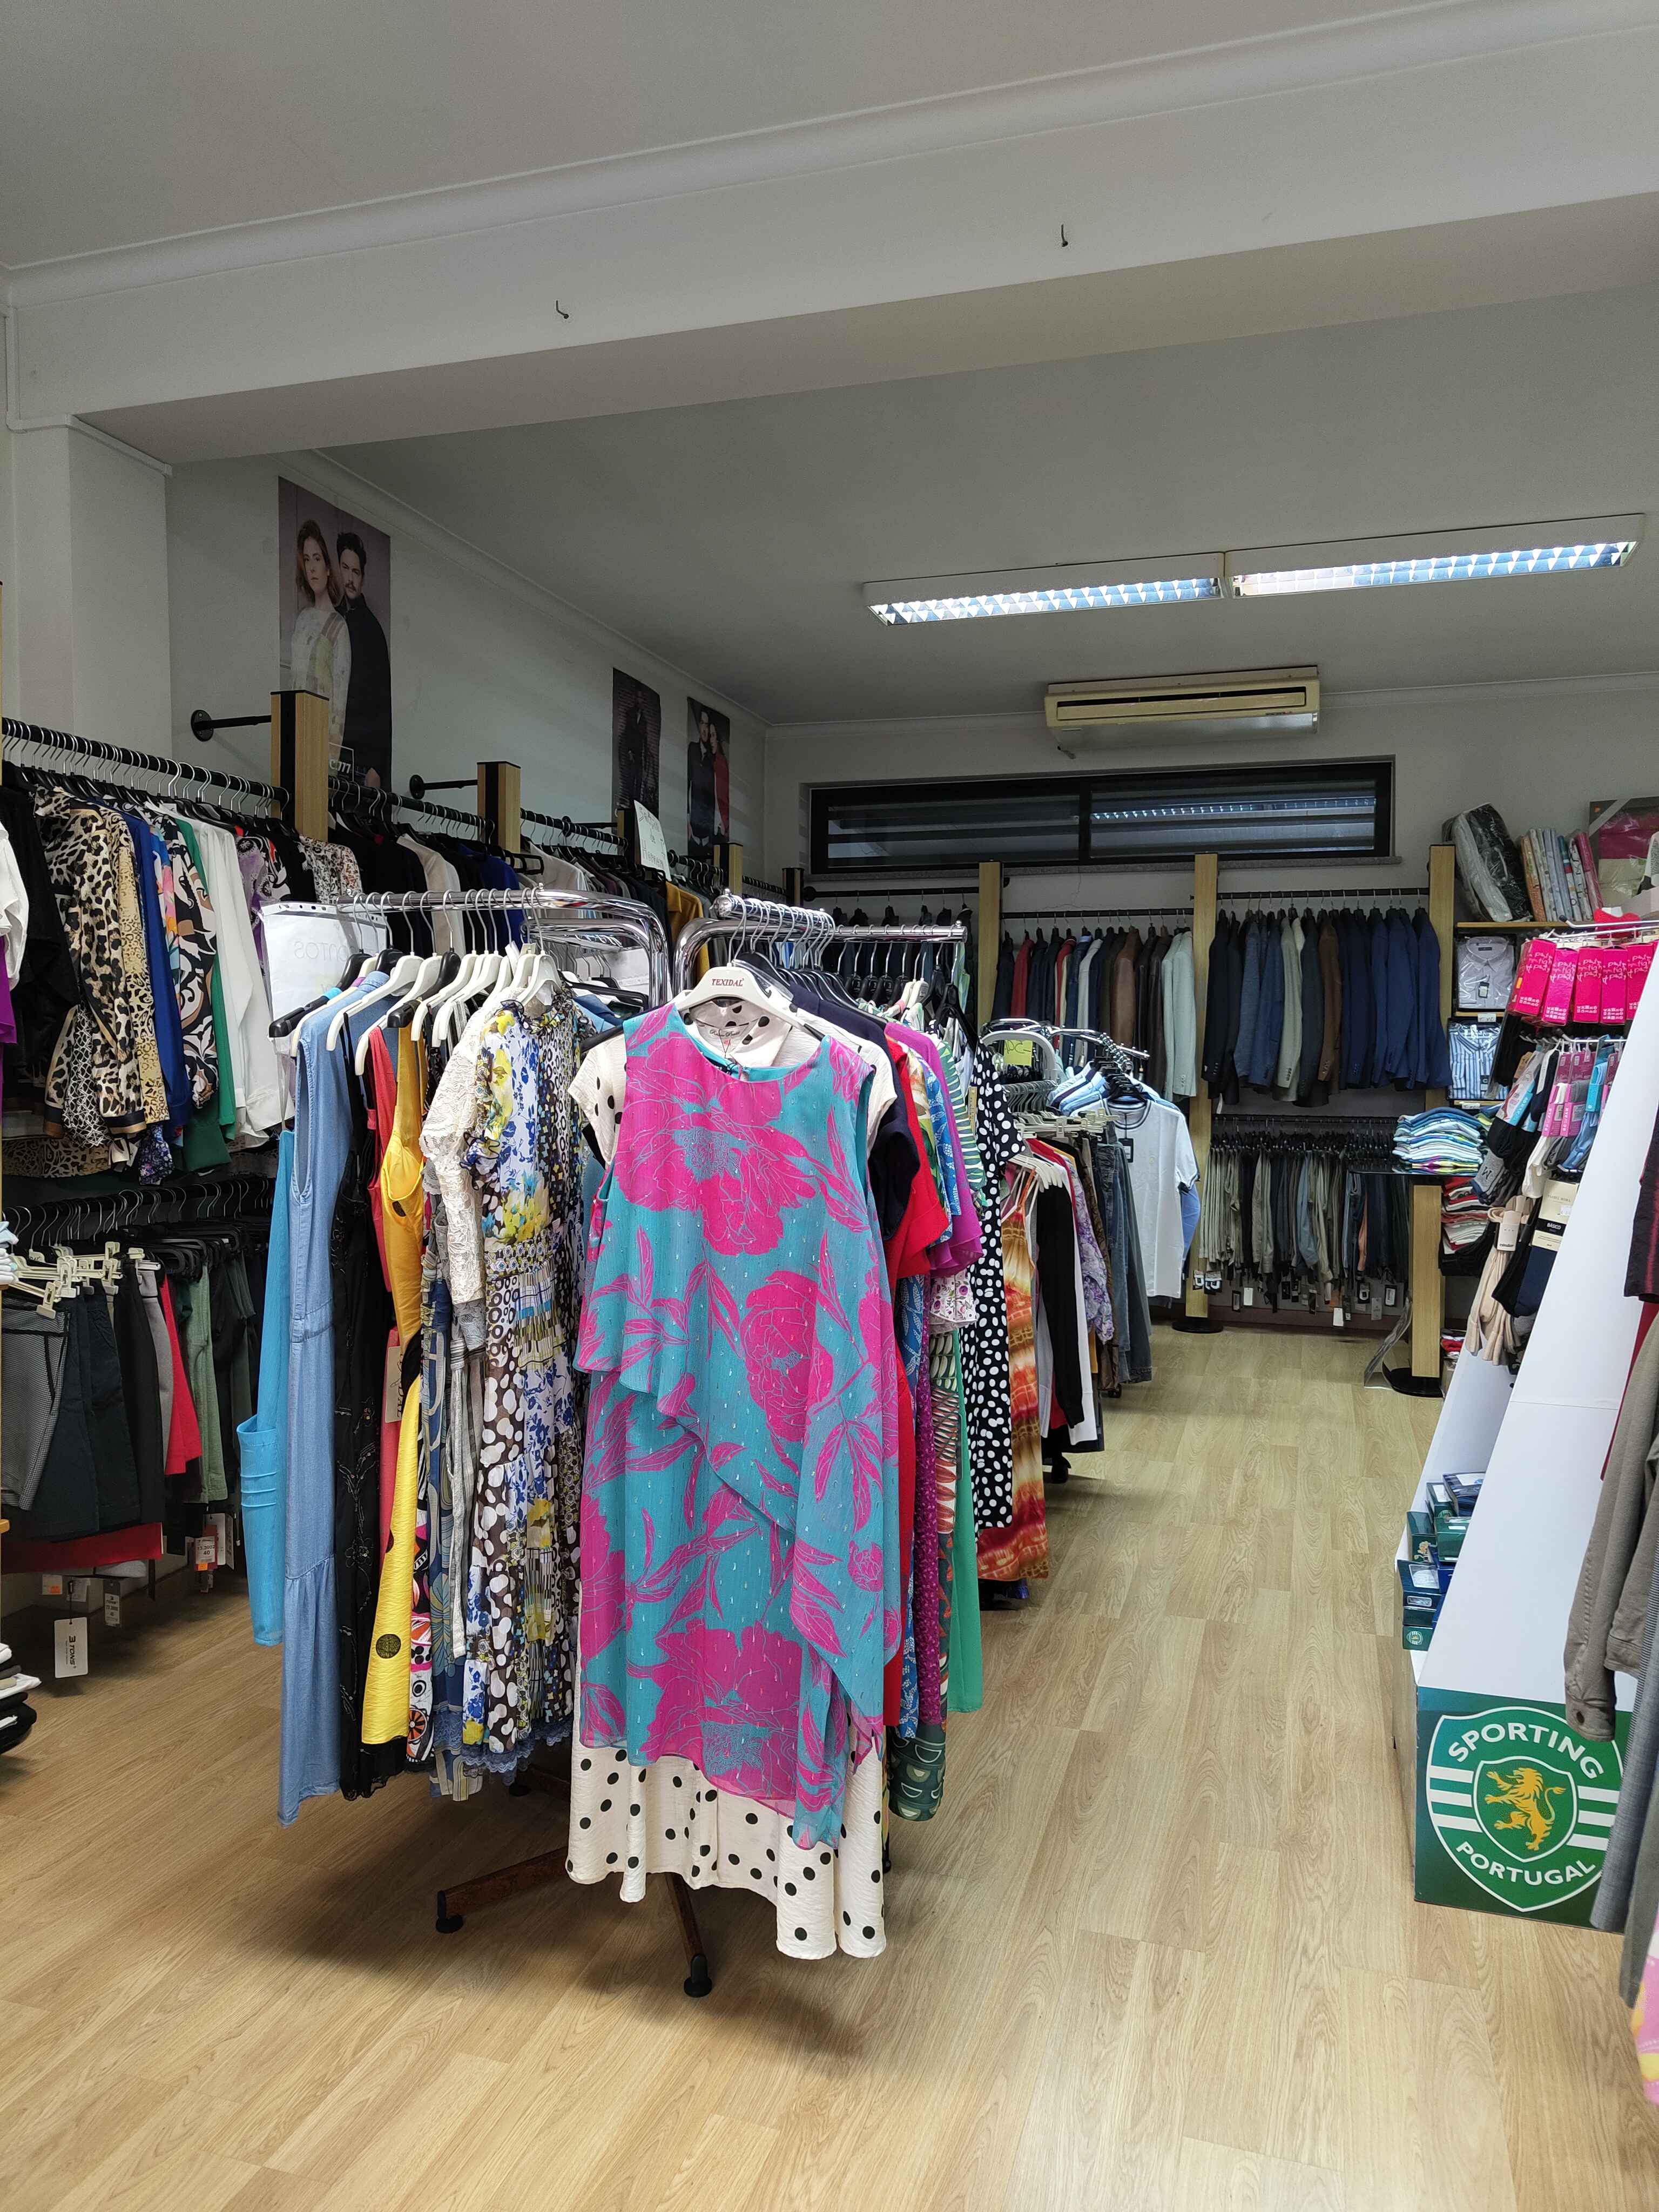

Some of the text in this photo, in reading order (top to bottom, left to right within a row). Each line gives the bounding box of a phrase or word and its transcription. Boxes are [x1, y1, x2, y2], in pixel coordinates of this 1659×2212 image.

[711, 978, 744, 987] TEXIDAL
[1448, 1722, 1604, 1779] SPORTING
[1455, 1841, 1596, 1886] PORTUGAL
